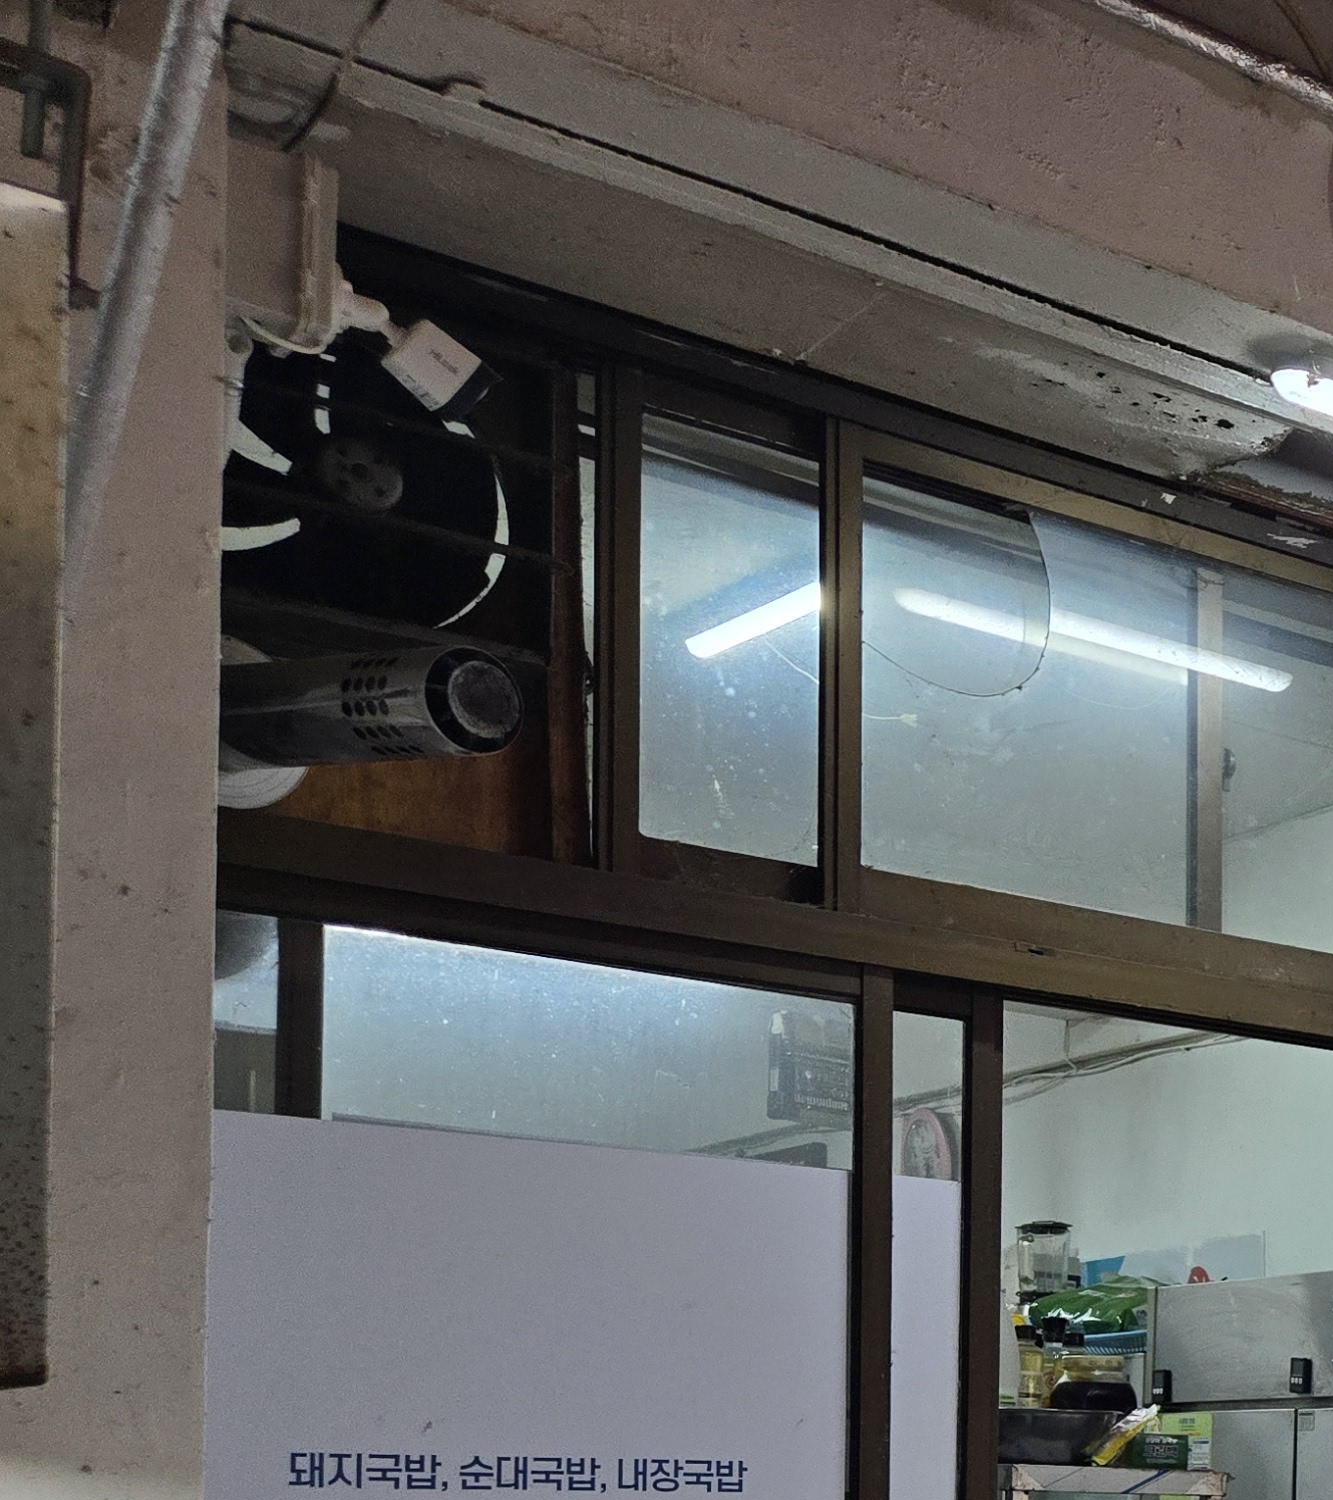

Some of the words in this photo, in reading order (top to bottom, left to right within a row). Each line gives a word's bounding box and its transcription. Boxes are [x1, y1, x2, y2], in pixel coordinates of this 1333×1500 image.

[288, 1452, 449, 1491] 돼지국밥,
[459, 1455, 608, 1494] 순대국밥,
[617, 1458, 748, 1493] 내장국밥
